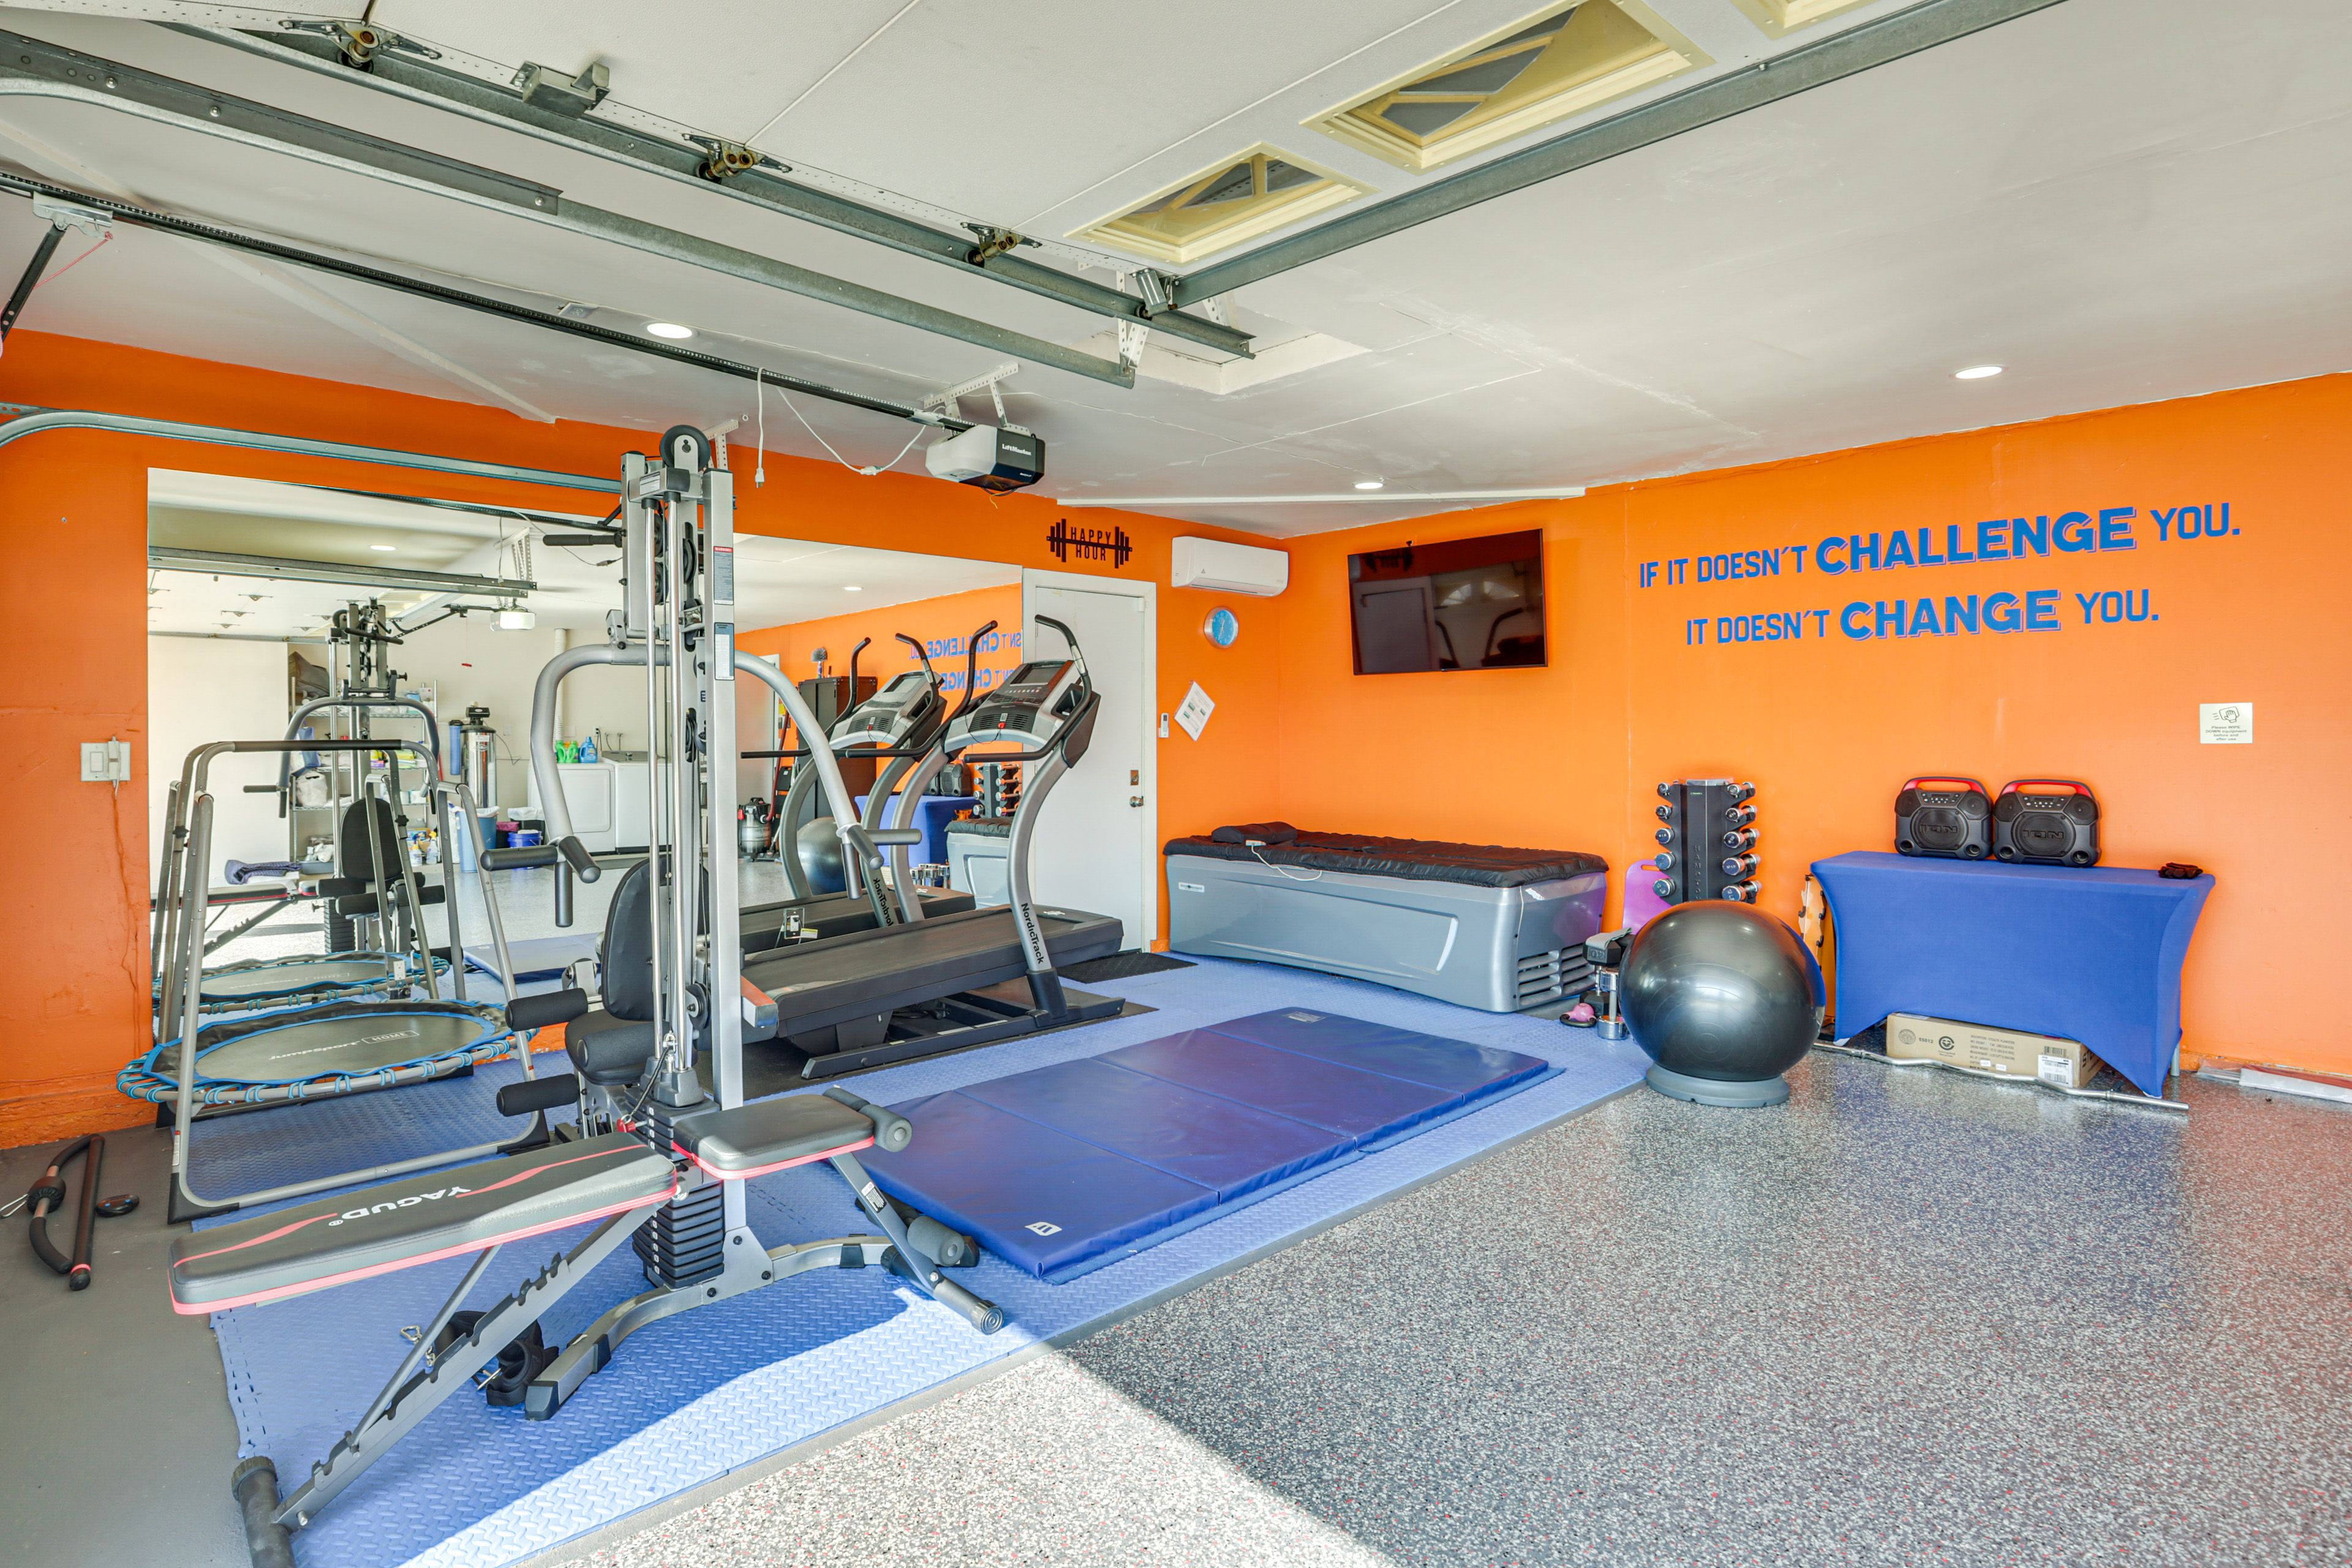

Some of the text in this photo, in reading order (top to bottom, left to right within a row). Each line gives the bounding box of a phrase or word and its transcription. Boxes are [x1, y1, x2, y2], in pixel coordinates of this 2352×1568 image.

[1071, 526, 1111, 545] HAPPY
[1076, 544, 1106, 561] HOUR
[1640, 502, 2242, 589] IF IT DOESN'T CHALLENGE YOU.
[1687, 589, 2160, 646] IT DOESN'T CHANGE YOU.
[1021, 903, 1044, 964] NordicTrack
[371, 1032, 409, 1042] HOME
